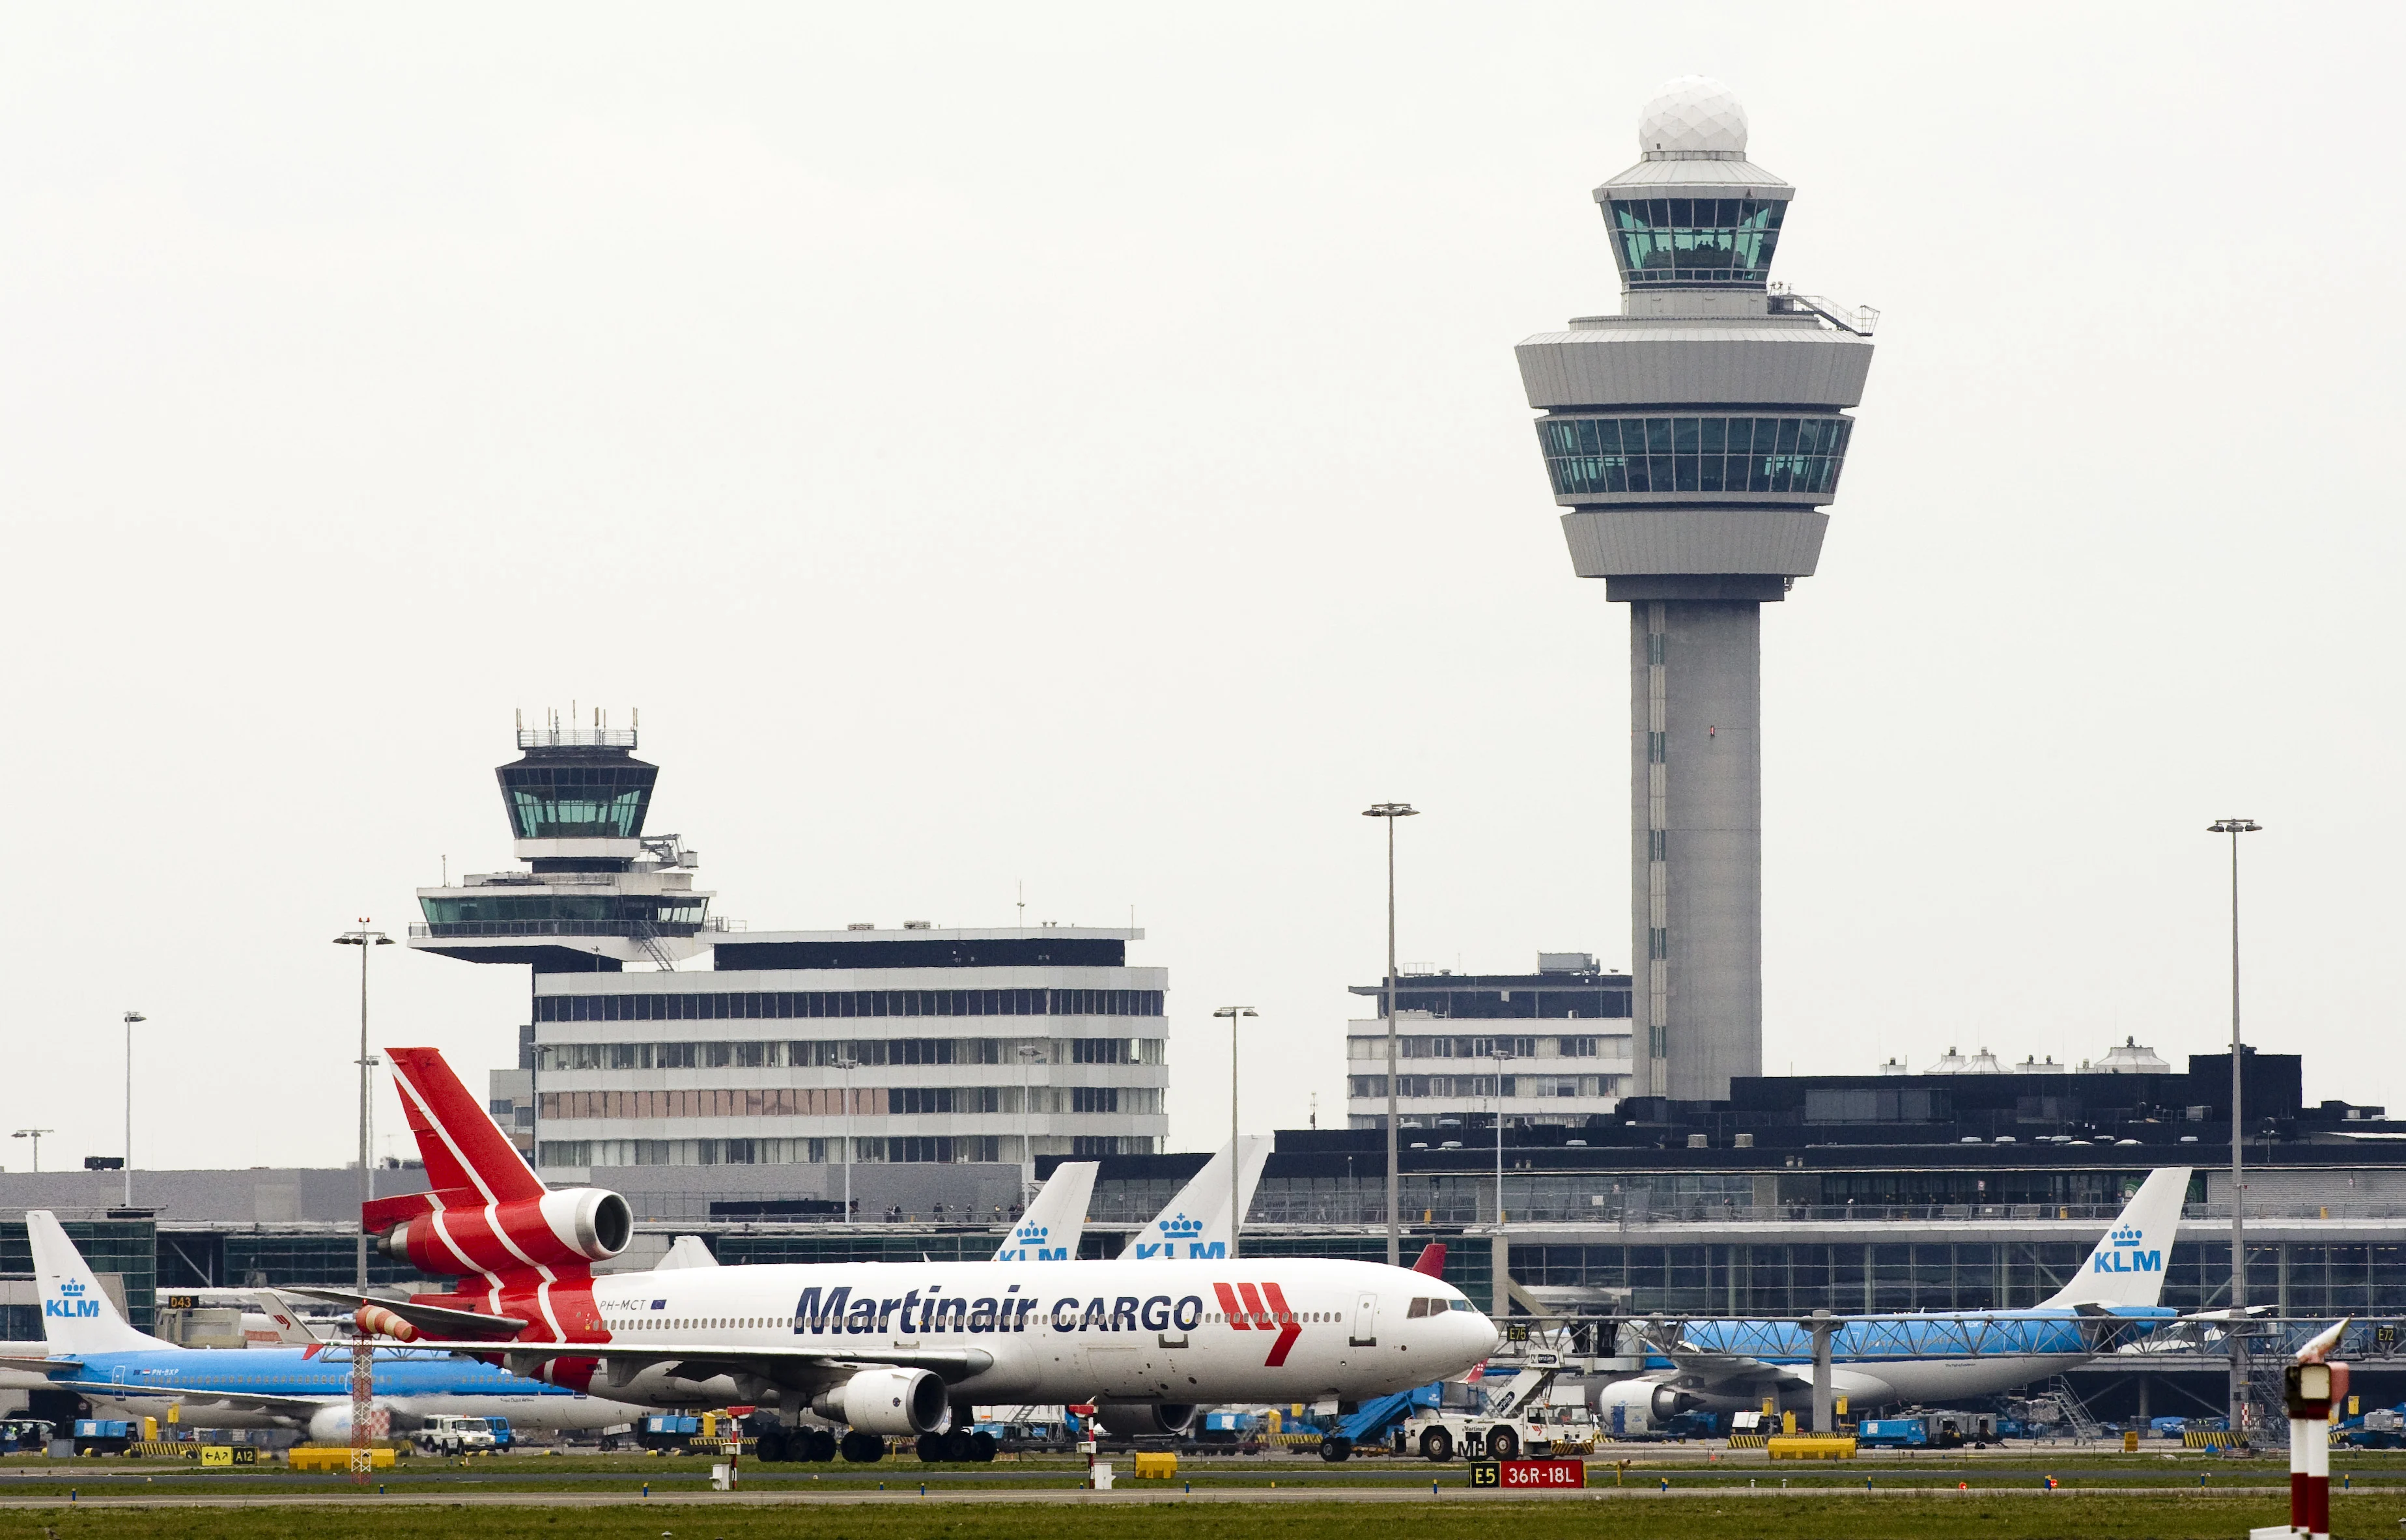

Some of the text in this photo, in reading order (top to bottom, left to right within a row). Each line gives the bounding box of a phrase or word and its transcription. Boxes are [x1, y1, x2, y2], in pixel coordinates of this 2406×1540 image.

[2095, 1250, 2161, 1273] KLM
[46, 1300, 99, 1317] KLM
[171, 1296, 191, 1308] D43
[599, 1299, 647, 1311] PH-MCT
[794, 1285, 1203, 1335] Martinair CARGO
[1510, 1328, 1527, 1340] E75
[2378, 1328, 2394, 1341] E72
[214, 1451, 221, 1461] A
[235, 1451, 253, 1462] A12
[1475, 1468, 1496, 1484] E5
[1508, 1467, 1575, 1484] 36R-18L
